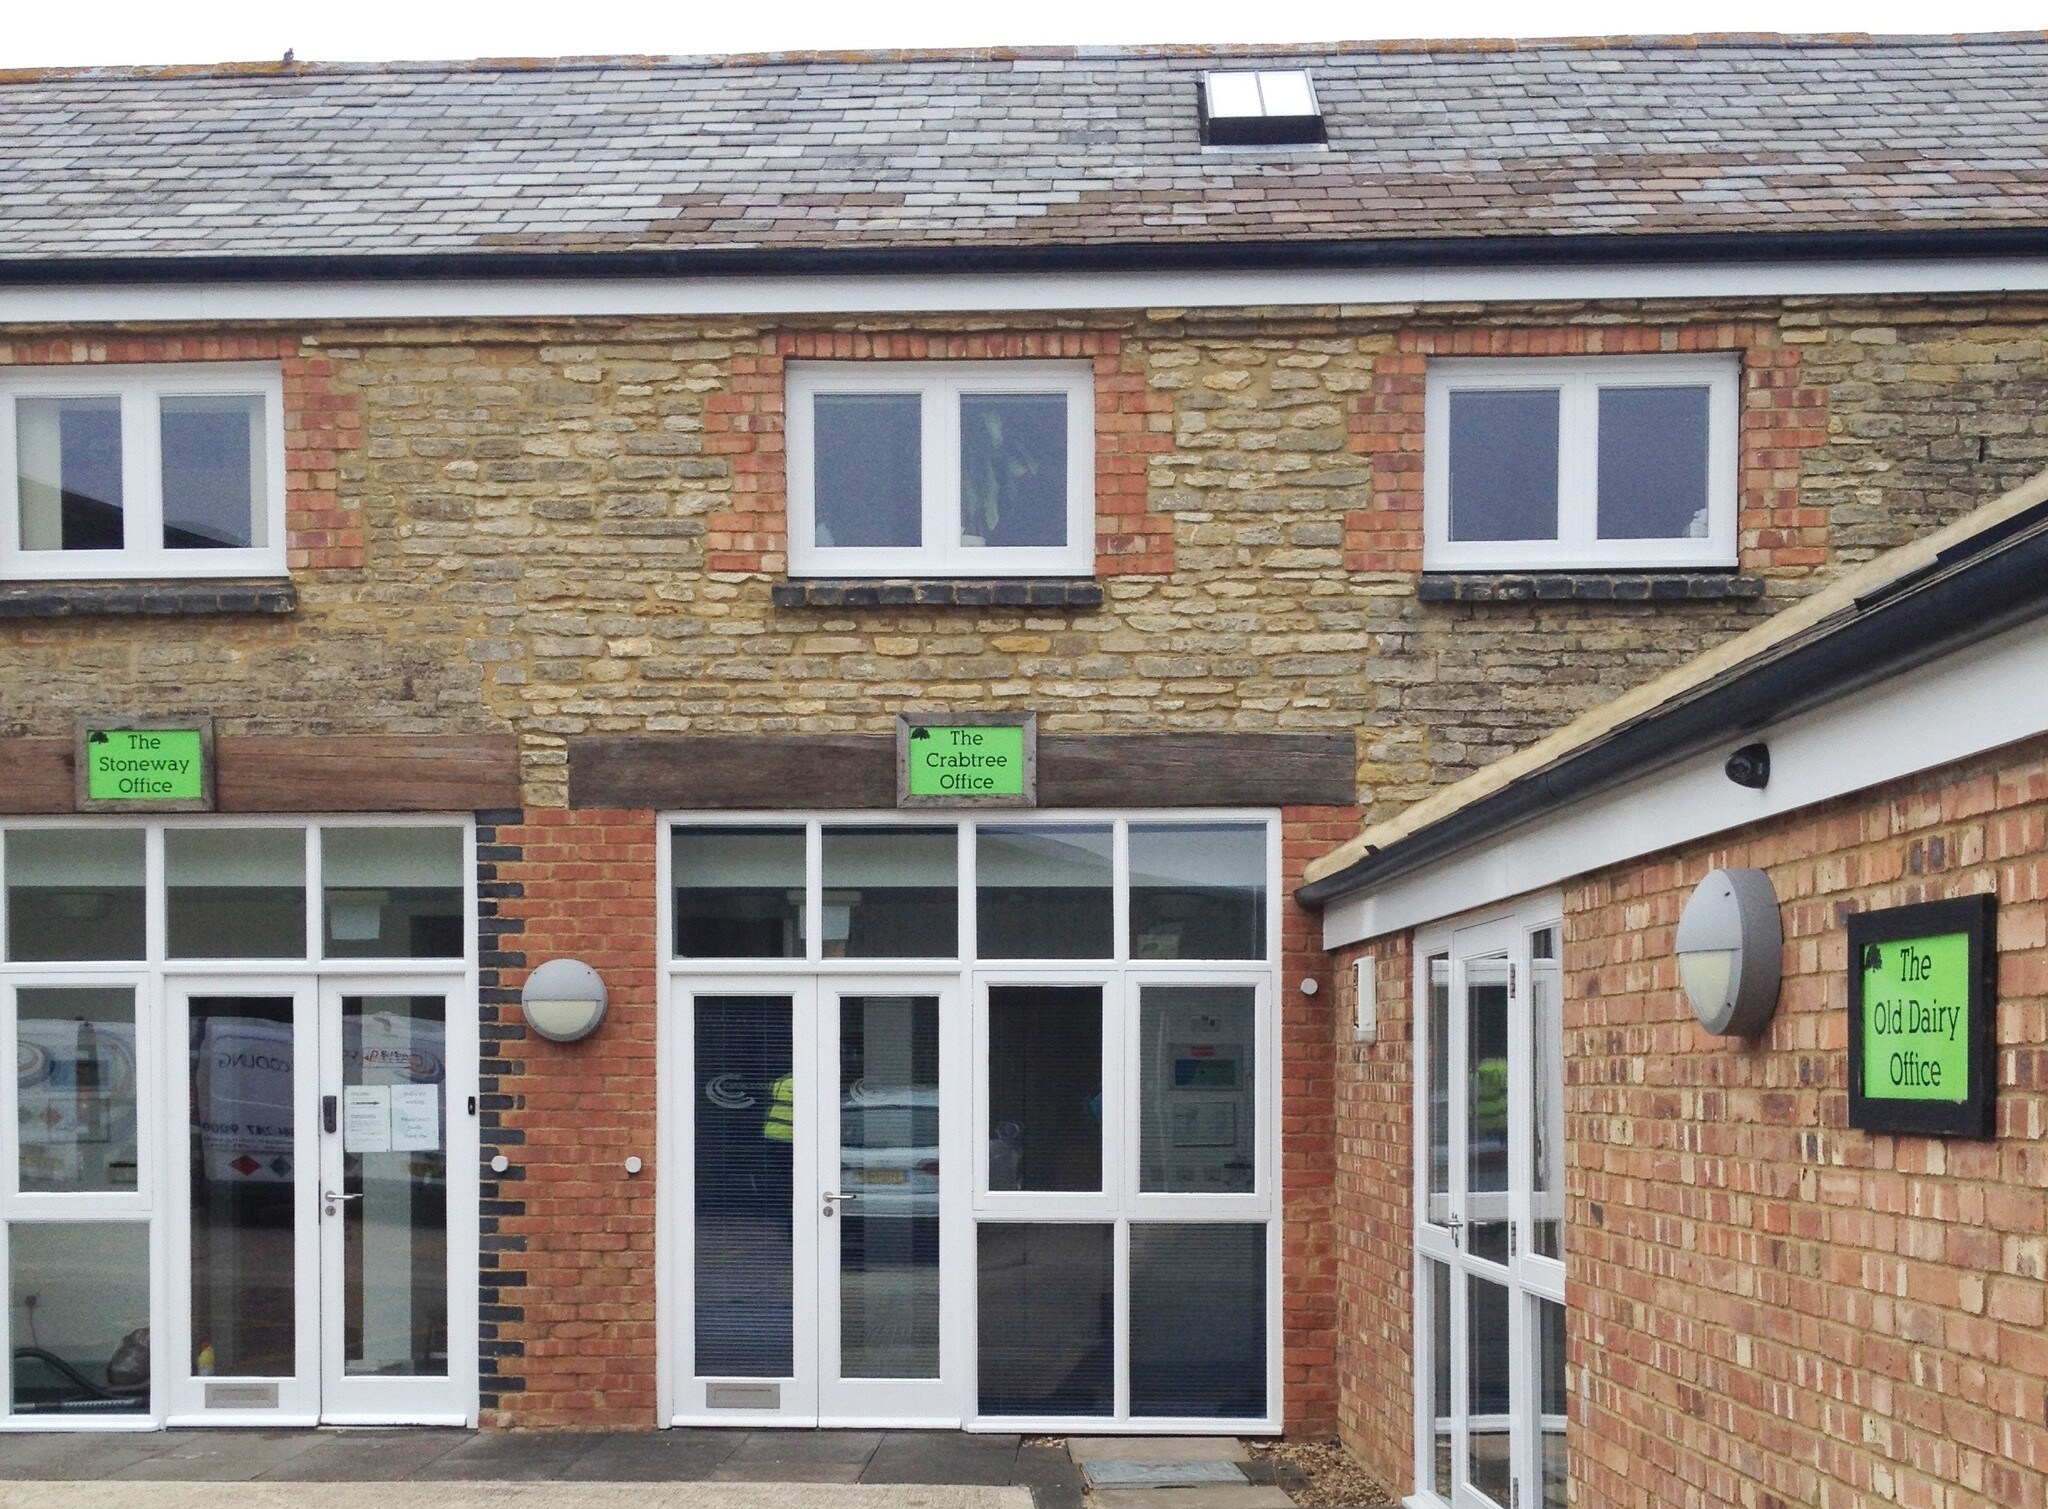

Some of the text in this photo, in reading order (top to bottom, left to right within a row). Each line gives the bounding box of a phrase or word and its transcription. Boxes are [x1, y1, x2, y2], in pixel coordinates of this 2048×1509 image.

[128, 734, 161, 750] The
[950, 730, 984, 746] The
[99, 756, 190, 774] Stoneway
[926, 752, 1008, 768] Crabtree
[118, 778, 173, 793] Office
[940, 774, 994, 789] Office
[1900, 946, 1932, 982] The
[1874, 999, 1960, 1041] Old Dairy
[1889, 1051, 1942, 1087] Office
